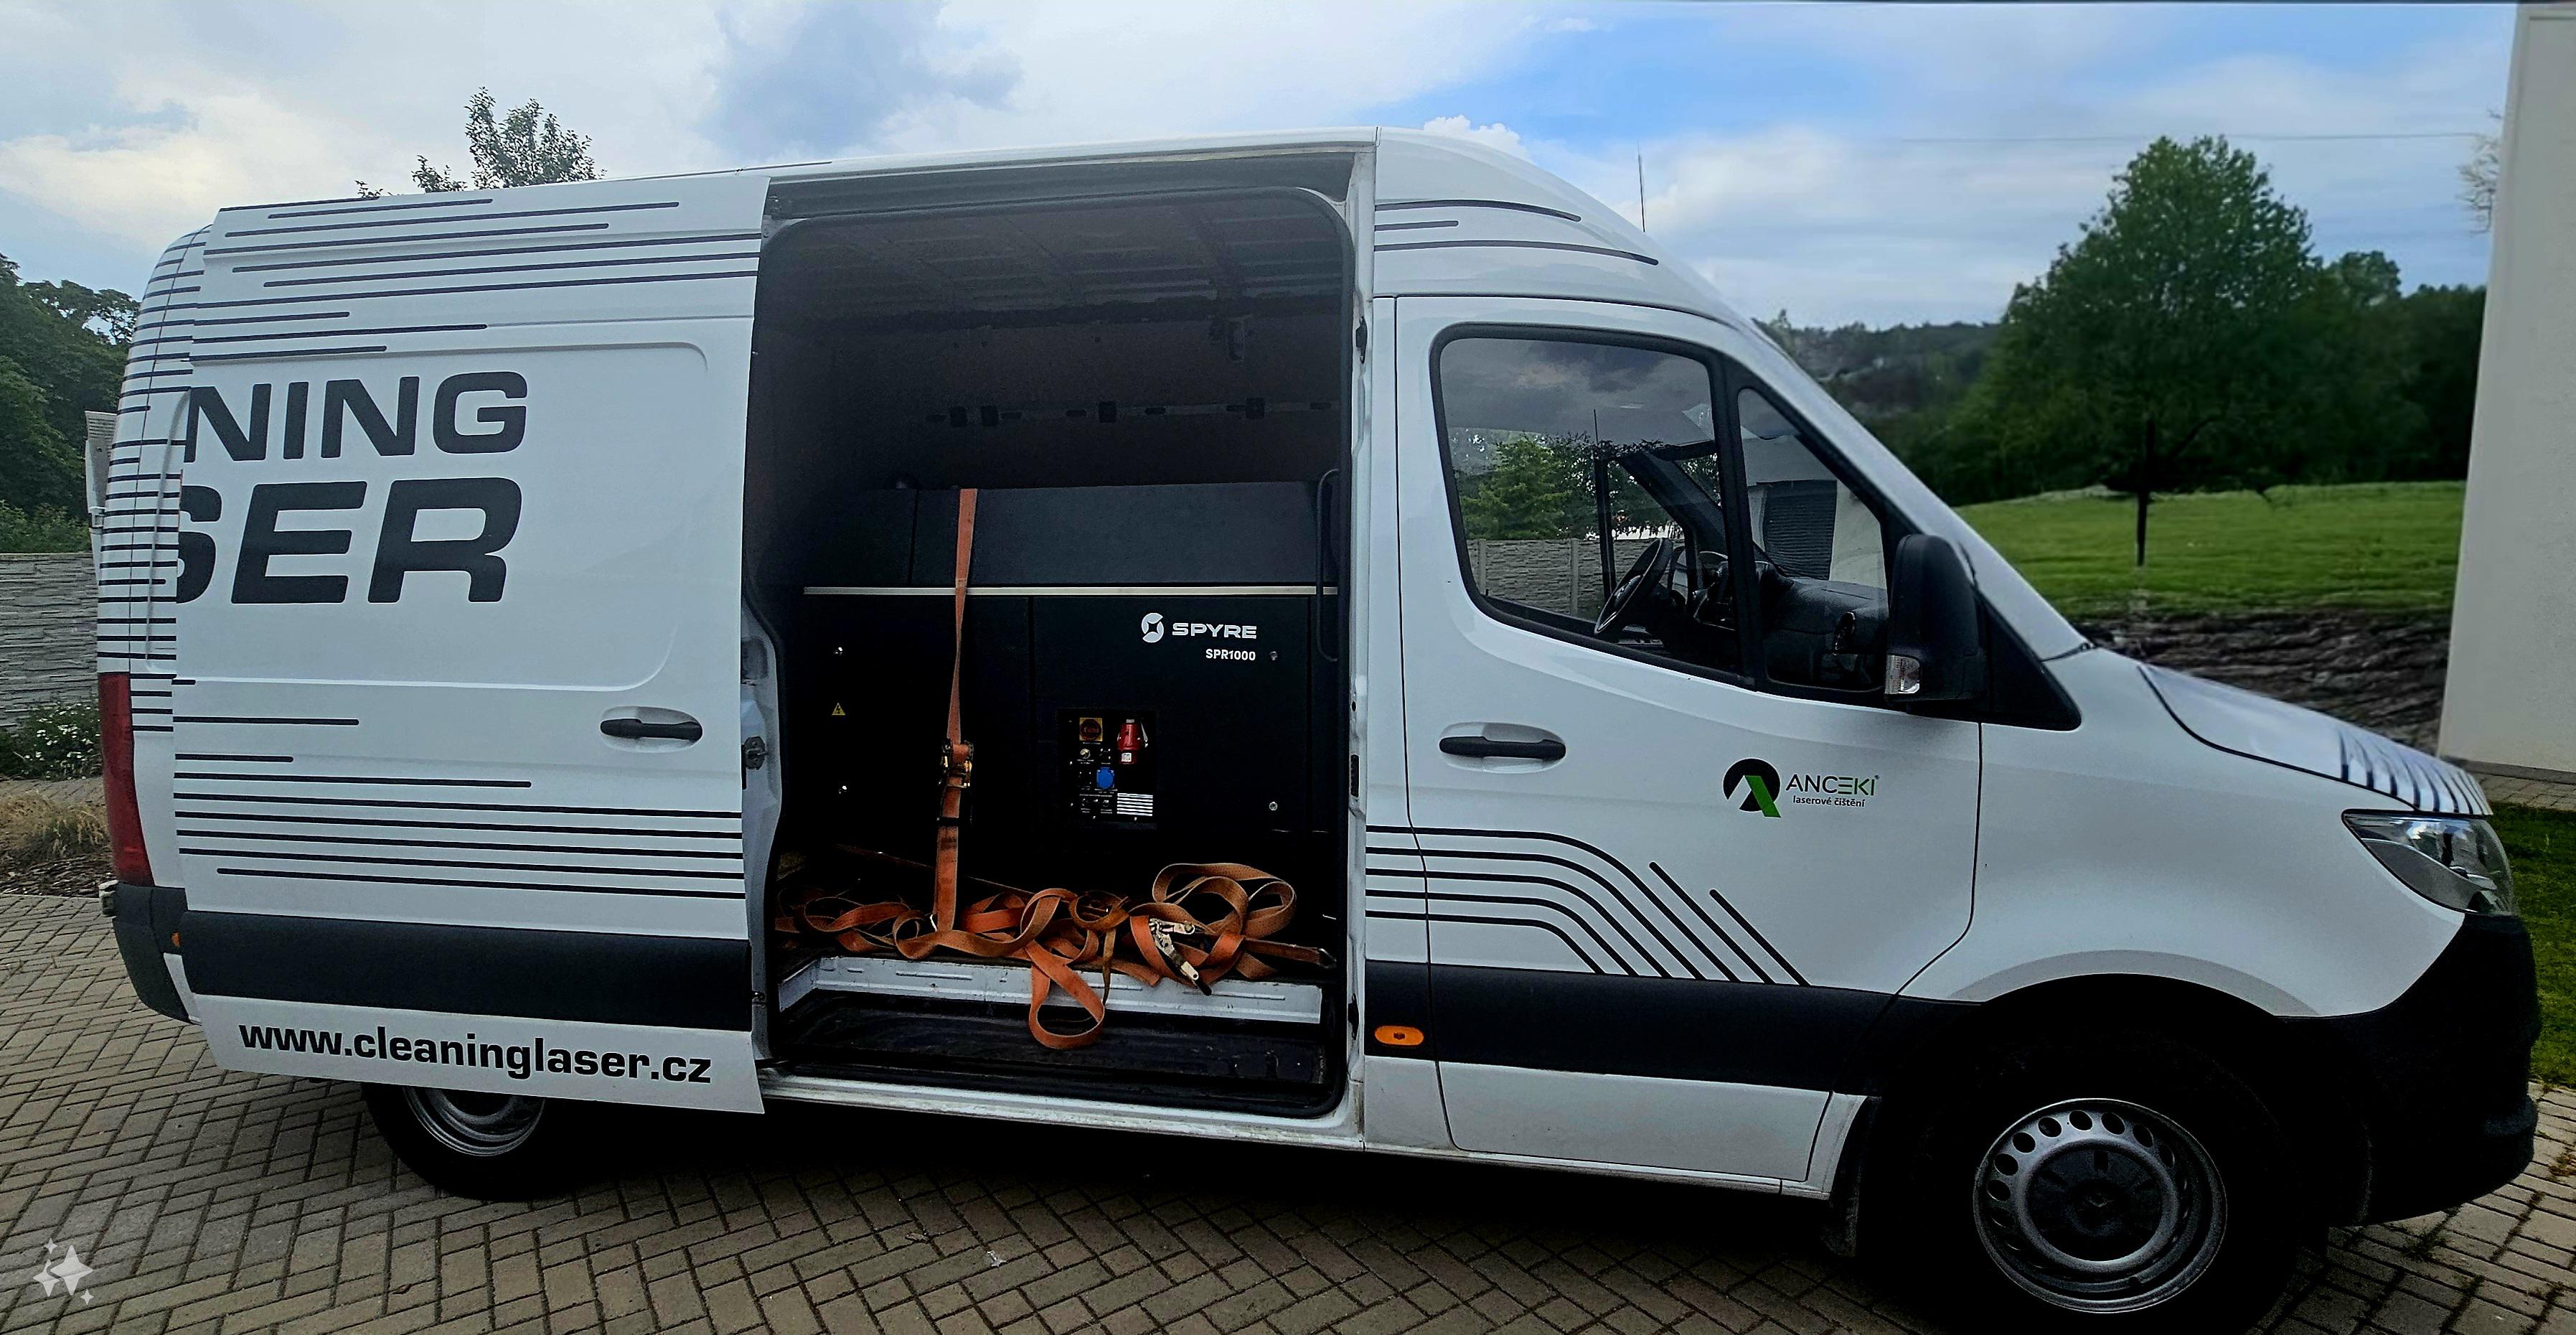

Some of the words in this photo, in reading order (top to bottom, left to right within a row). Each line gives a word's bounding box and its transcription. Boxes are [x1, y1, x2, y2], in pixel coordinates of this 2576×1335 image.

[184, 371, 527, 463] NING
[1172, 622, 1257, 640] SPYRE
[1205, 648, 1256, 661] SPR1000
[1792, 795, 1832, 806] laserové
[1834, 797, 1866, 807] čištění
[239, 1024, 713, 1084] www.cleaninglaser.cz
